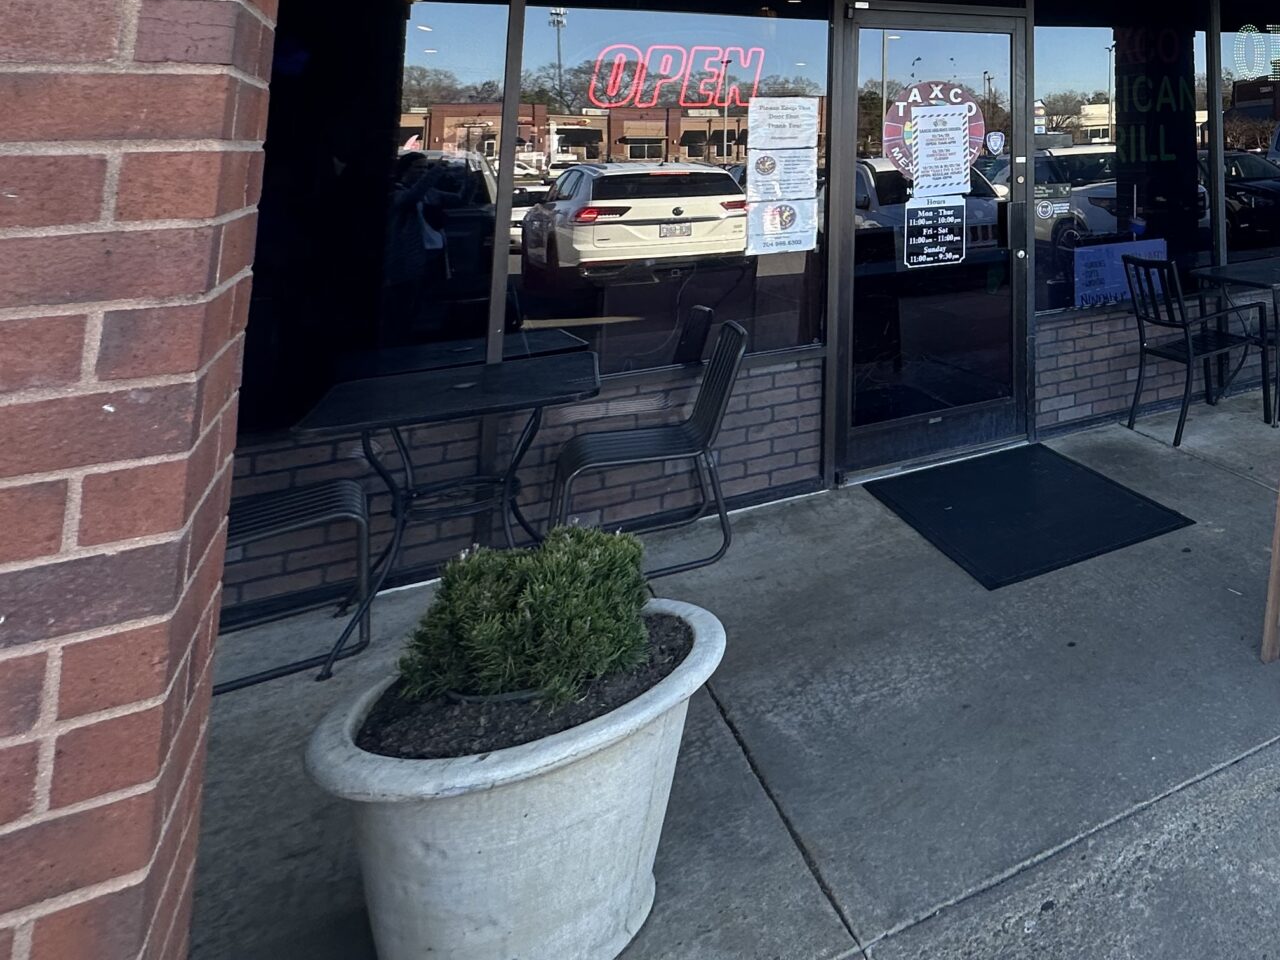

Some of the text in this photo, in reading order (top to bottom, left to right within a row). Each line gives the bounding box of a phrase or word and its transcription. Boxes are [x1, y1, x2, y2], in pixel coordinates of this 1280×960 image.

[589, 44, 765, 108] OPEN
[895, 84, 977, 117] TAXCO
[924, 245, 947, 253] Sunday
